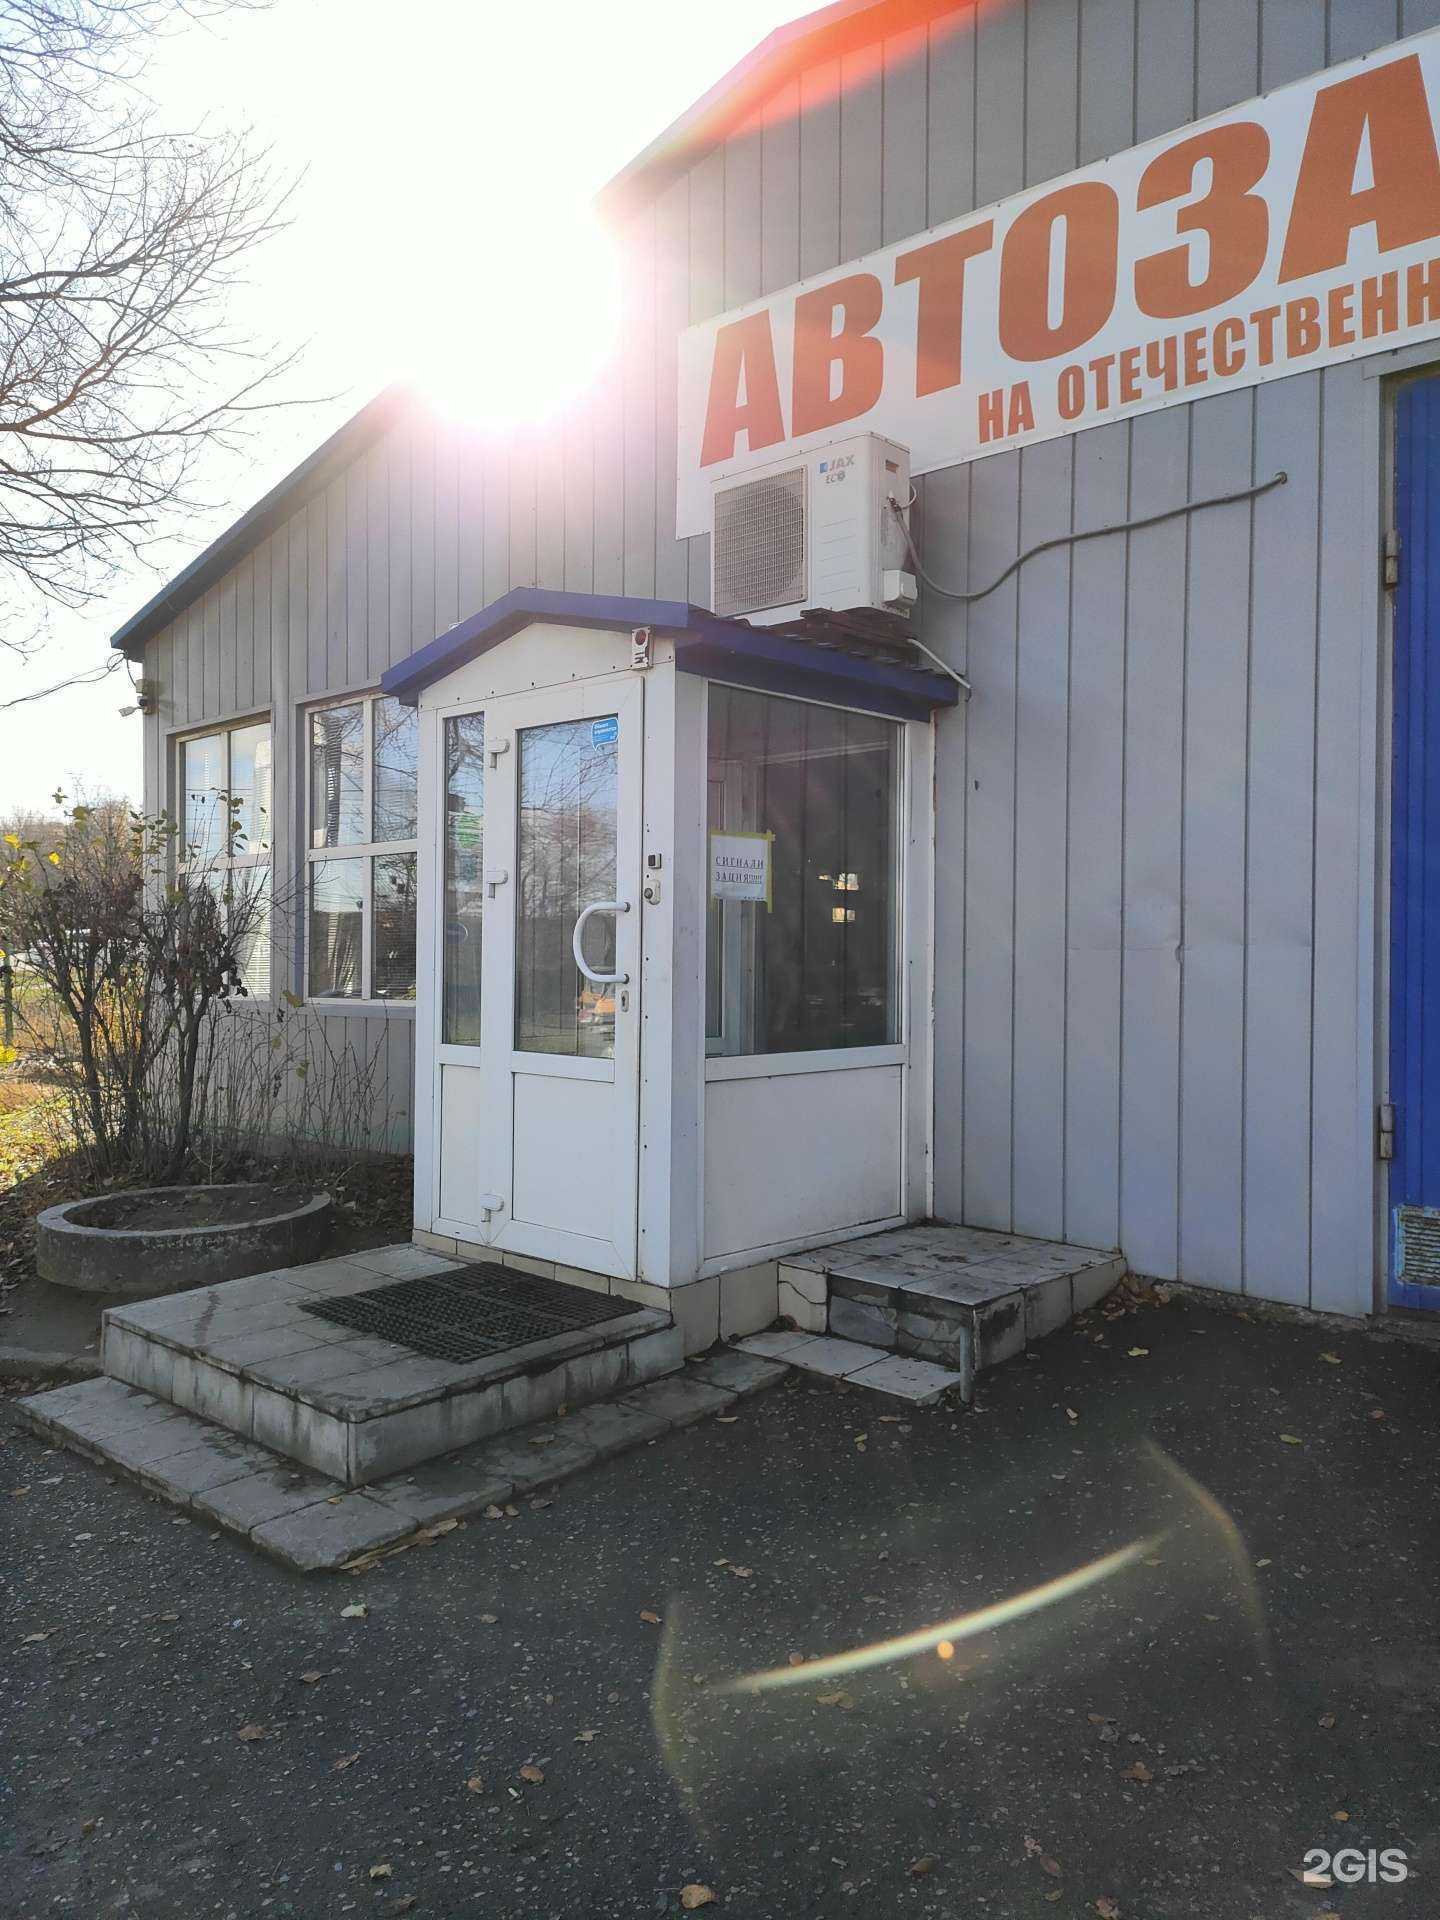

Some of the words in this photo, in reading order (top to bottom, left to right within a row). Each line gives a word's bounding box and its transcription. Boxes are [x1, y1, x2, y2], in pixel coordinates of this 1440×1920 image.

[700, 53, 1440, 467] АВТОЗА
[978, 380, 1035, 444] НА
[1057, 257, 1440, 420] ОТЕЧЕСТВЕНН
[715, 856, 764, 870] СИГНАЛИ
